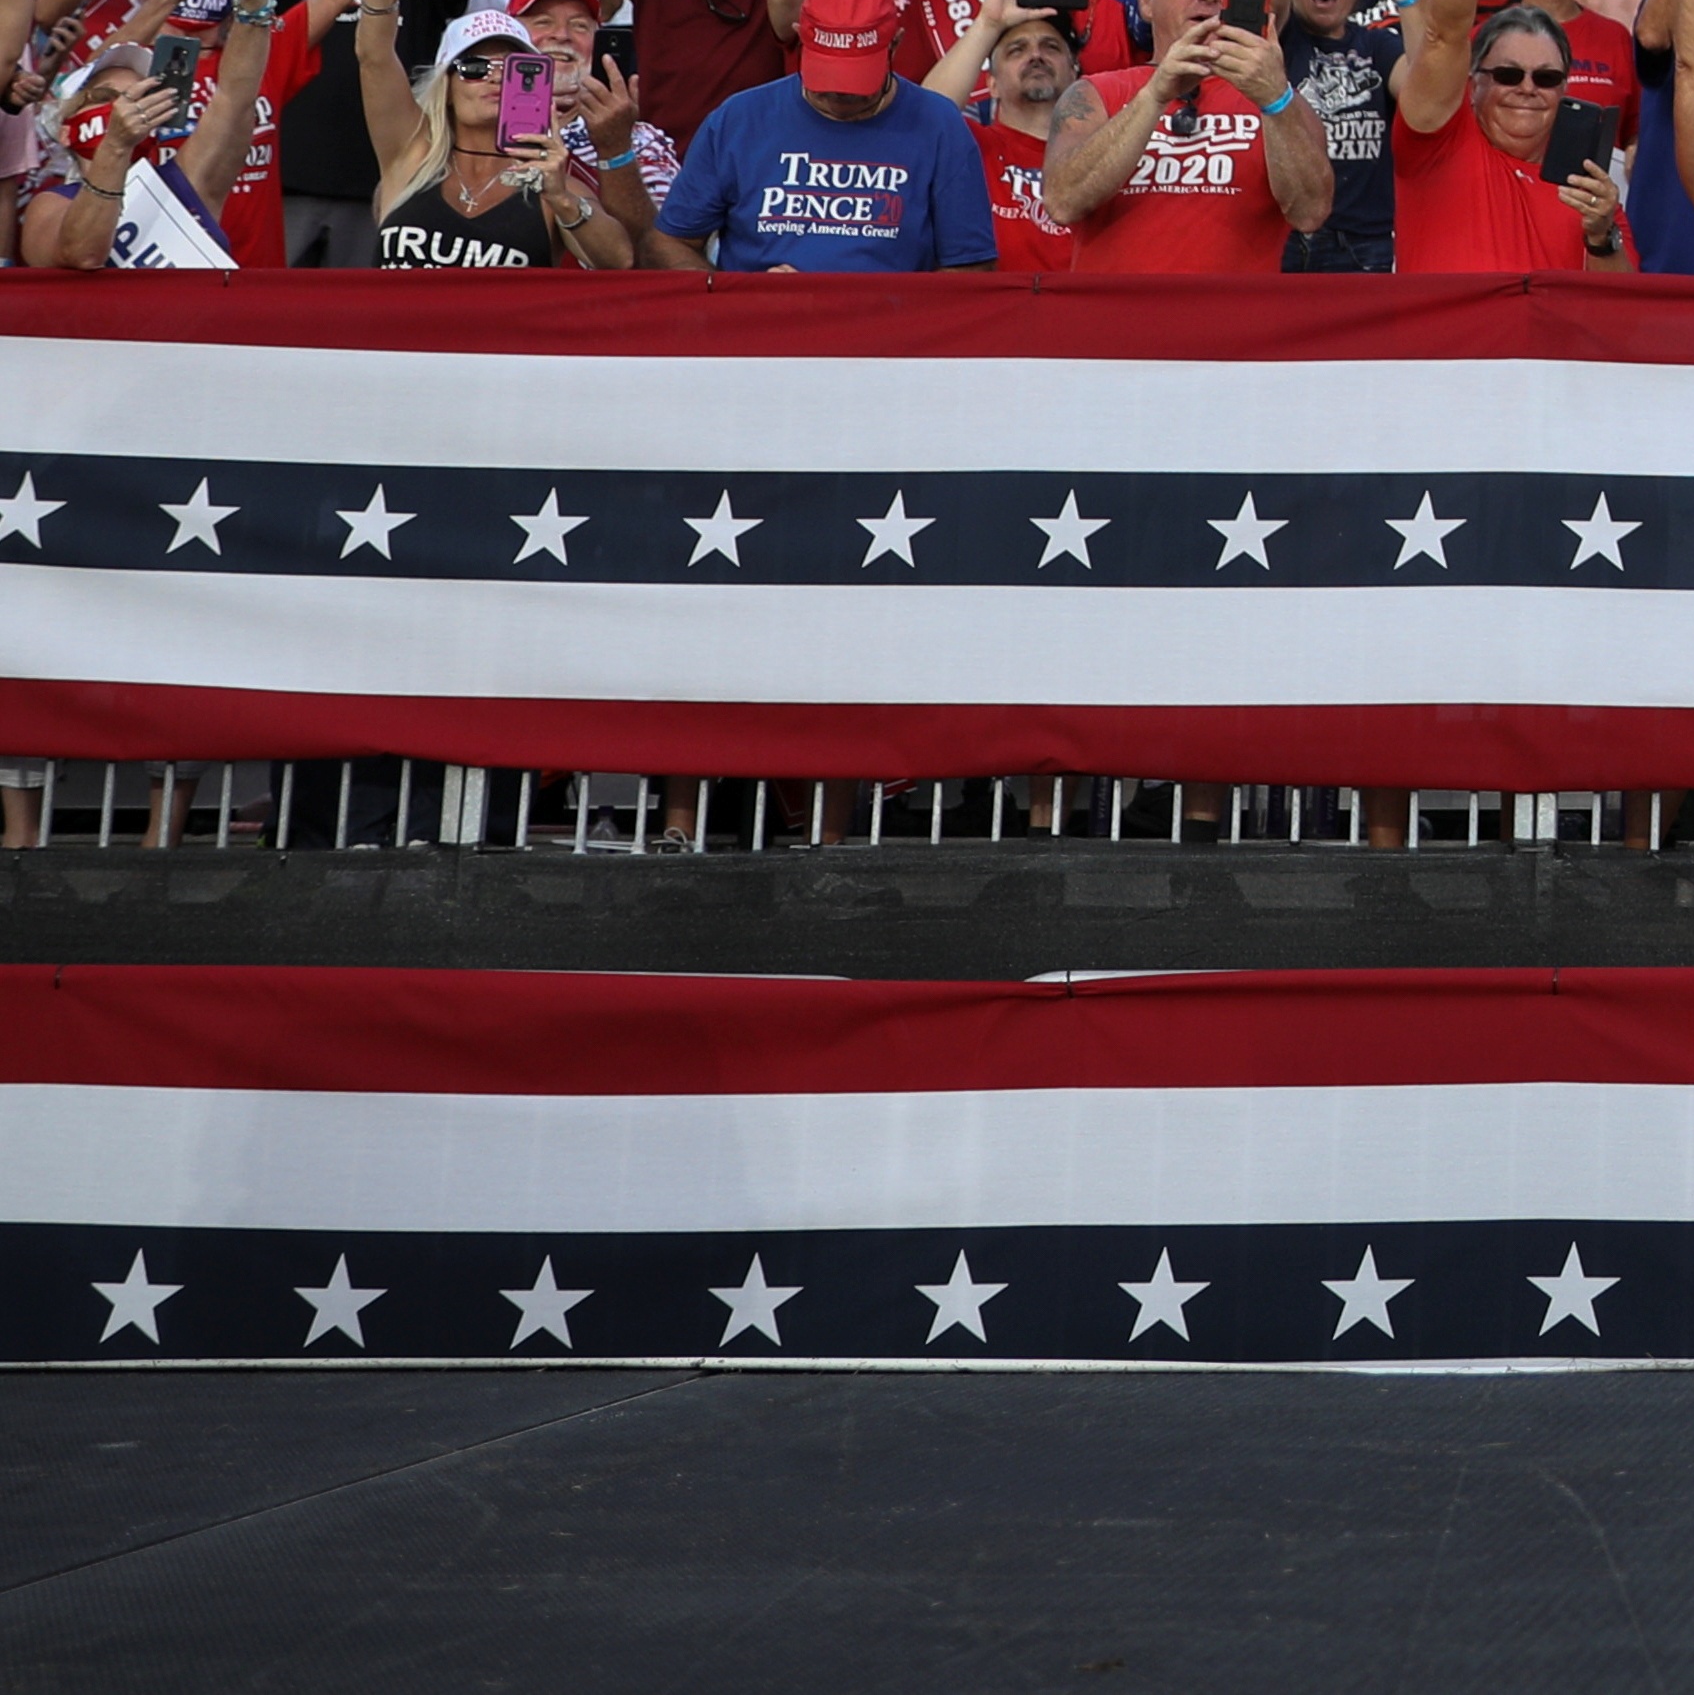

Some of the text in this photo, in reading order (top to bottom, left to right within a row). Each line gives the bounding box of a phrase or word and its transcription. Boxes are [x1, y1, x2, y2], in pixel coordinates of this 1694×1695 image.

[814, 28, 878, 49] TRUMP 2020
[1322, 120, 1386, 140] RUMP
[1327, 141, 1382, 160] RAIN
[780, 153, 908, 192] TRUMP
[1129, 154, 1233, 185] 2020
[1149, 185, 1199, 194] AMERICA
[758, 188, 873, 221] PENCE
[757, 221, 899, 239] Keeping America Great!
[381, 226, 530, 268] TRUMP
